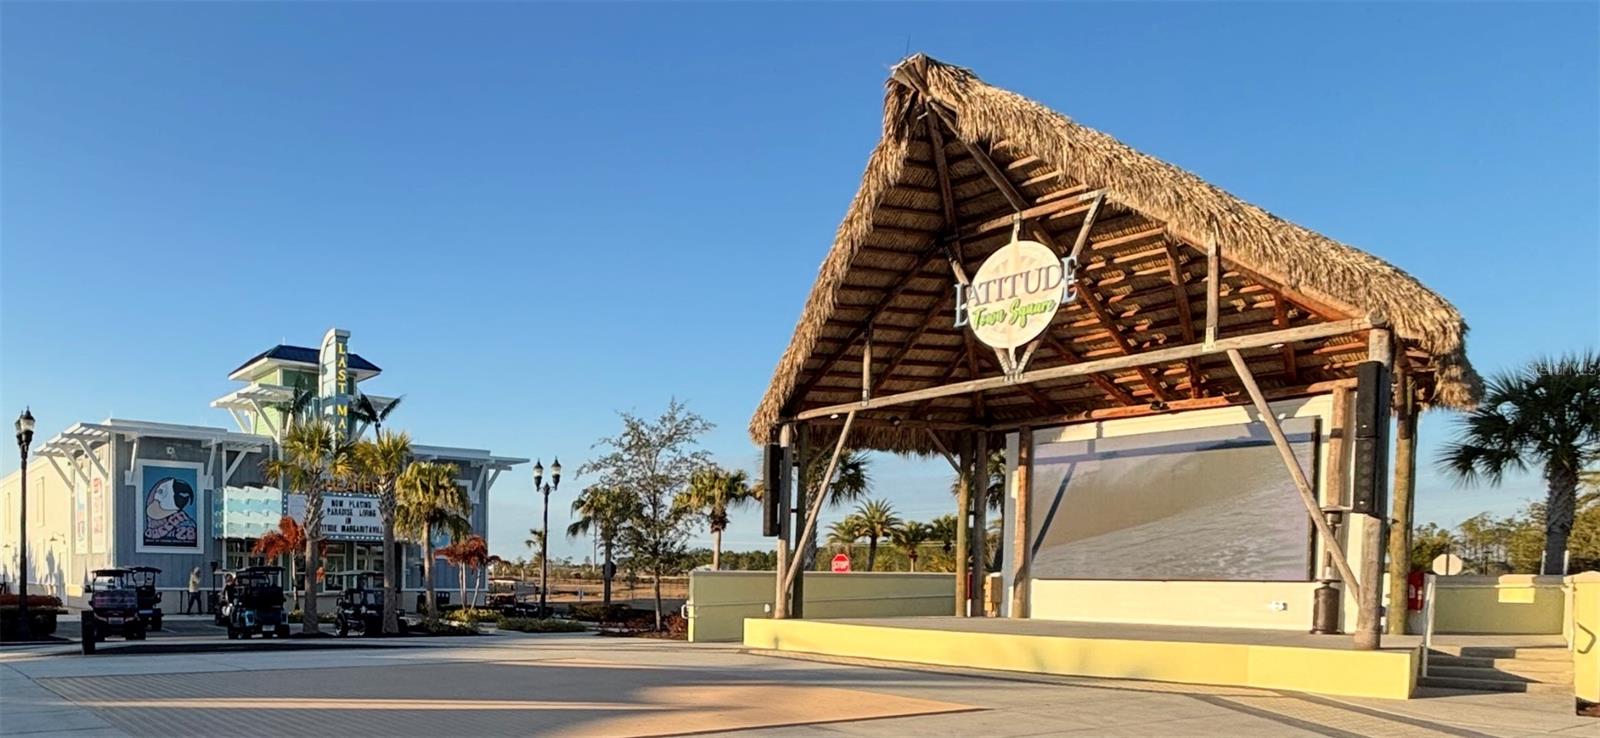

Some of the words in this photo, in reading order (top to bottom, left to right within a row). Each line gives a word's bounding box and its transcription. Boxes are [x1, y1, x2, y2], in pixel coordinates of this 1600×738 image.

[954, 255, 1078, 328] LATITUDE
[972, 305, 1006, 330] Town
[1008, 297, 1056, 329] Square
[336, 342, 347, 394] LAST
[336, 404, 347, 442] MAN
[327, 507, 353, 516] PARADISE
[359, 509, 376, 517] LIVING
[349, 500, 371, 508] PLAYING
[341, 524, 383, 534] MARGARITAVILL
[832, 560, 849, 569] STOP
